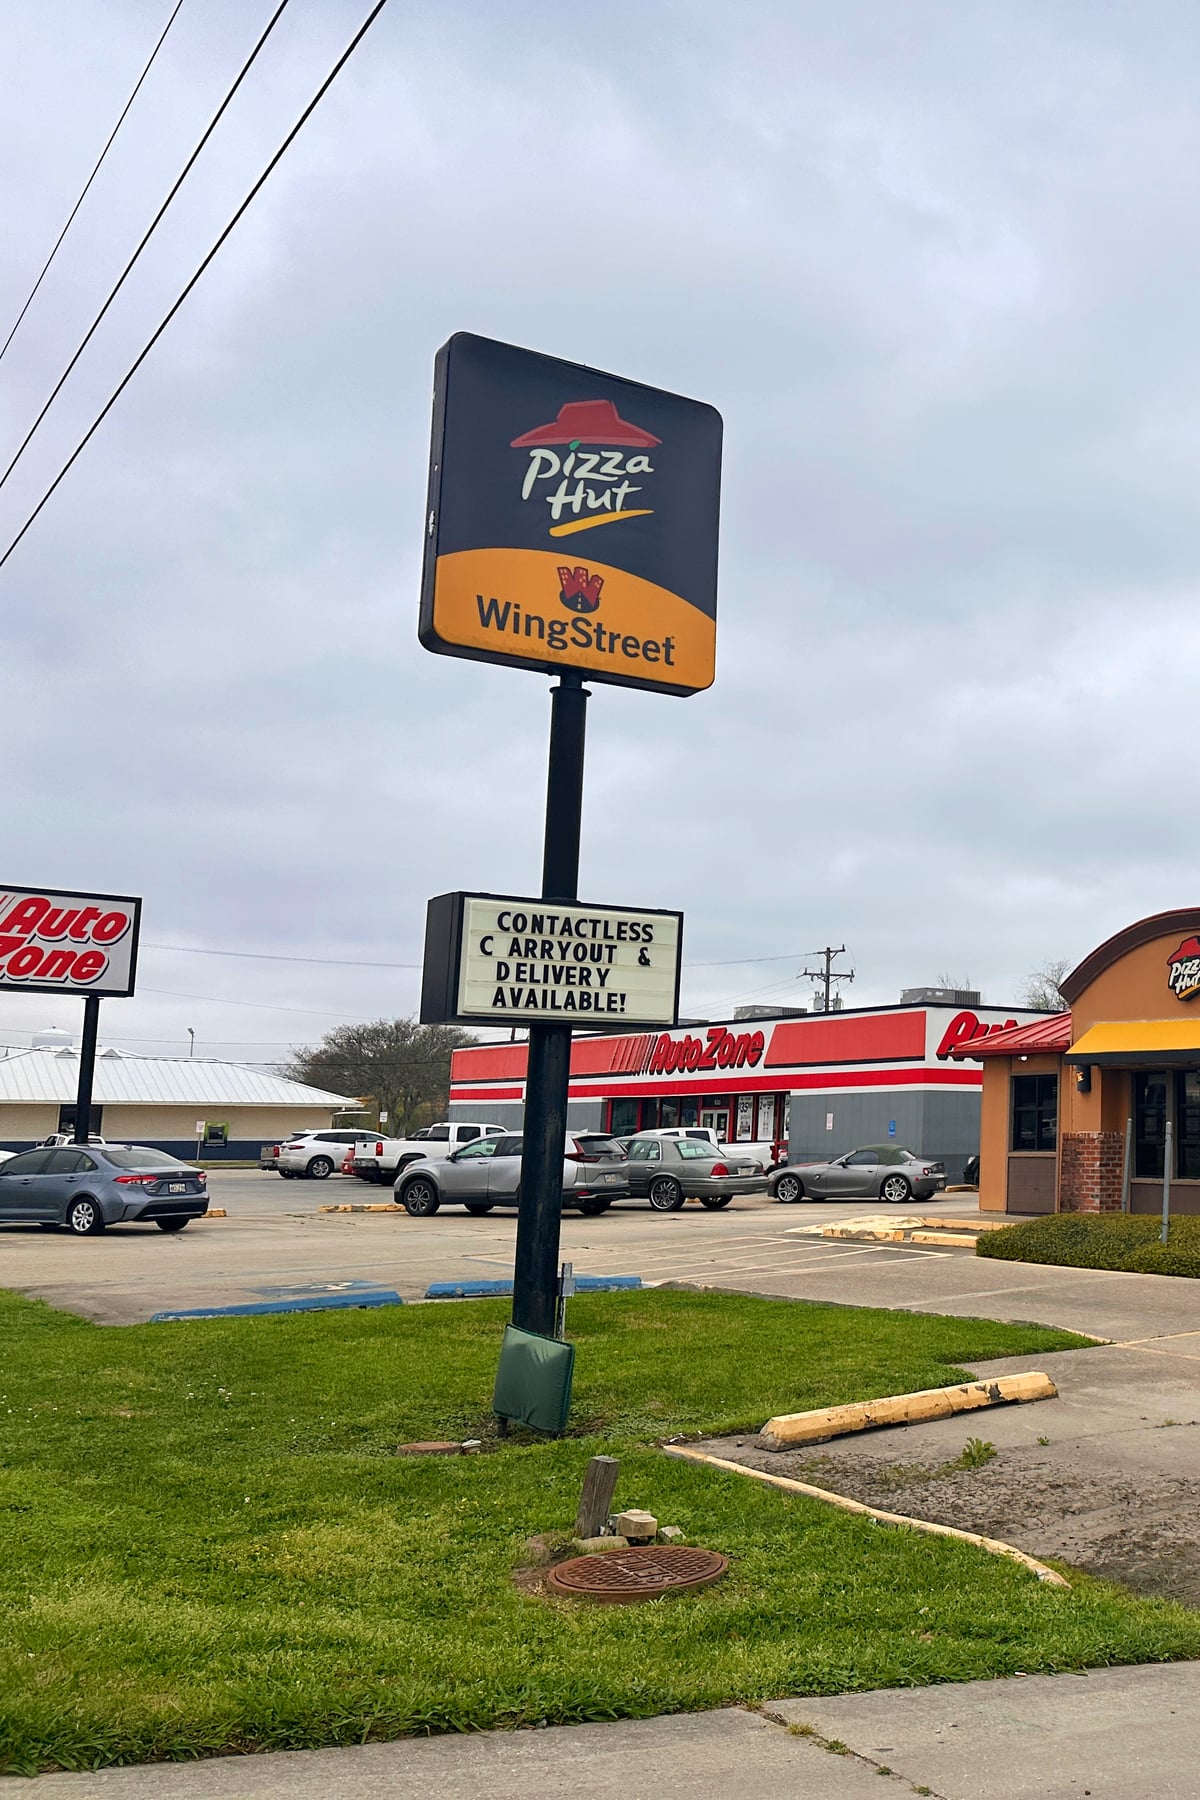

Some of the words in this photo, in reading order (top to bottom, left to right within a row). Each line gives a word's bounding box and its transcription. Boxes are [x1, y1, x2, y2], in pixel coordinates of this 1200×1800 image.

[521, 440, 655, 500] Pizza
[546, 480, 643, 520] Hut
[476, 595, 675, 666] WingStreet
[0, 897, 129, 942] Auto
[497, 911, 654, 943] CONTACTLESS
[480, 935, 618, 964] CARRYOUT
[637, 946, 651, 966] &
[496, 961, 611, 987] DELIVERY
[491, 986, 627, 1012] AVAILABLE!
[650, 1027, 765, 1075] AutoZone
